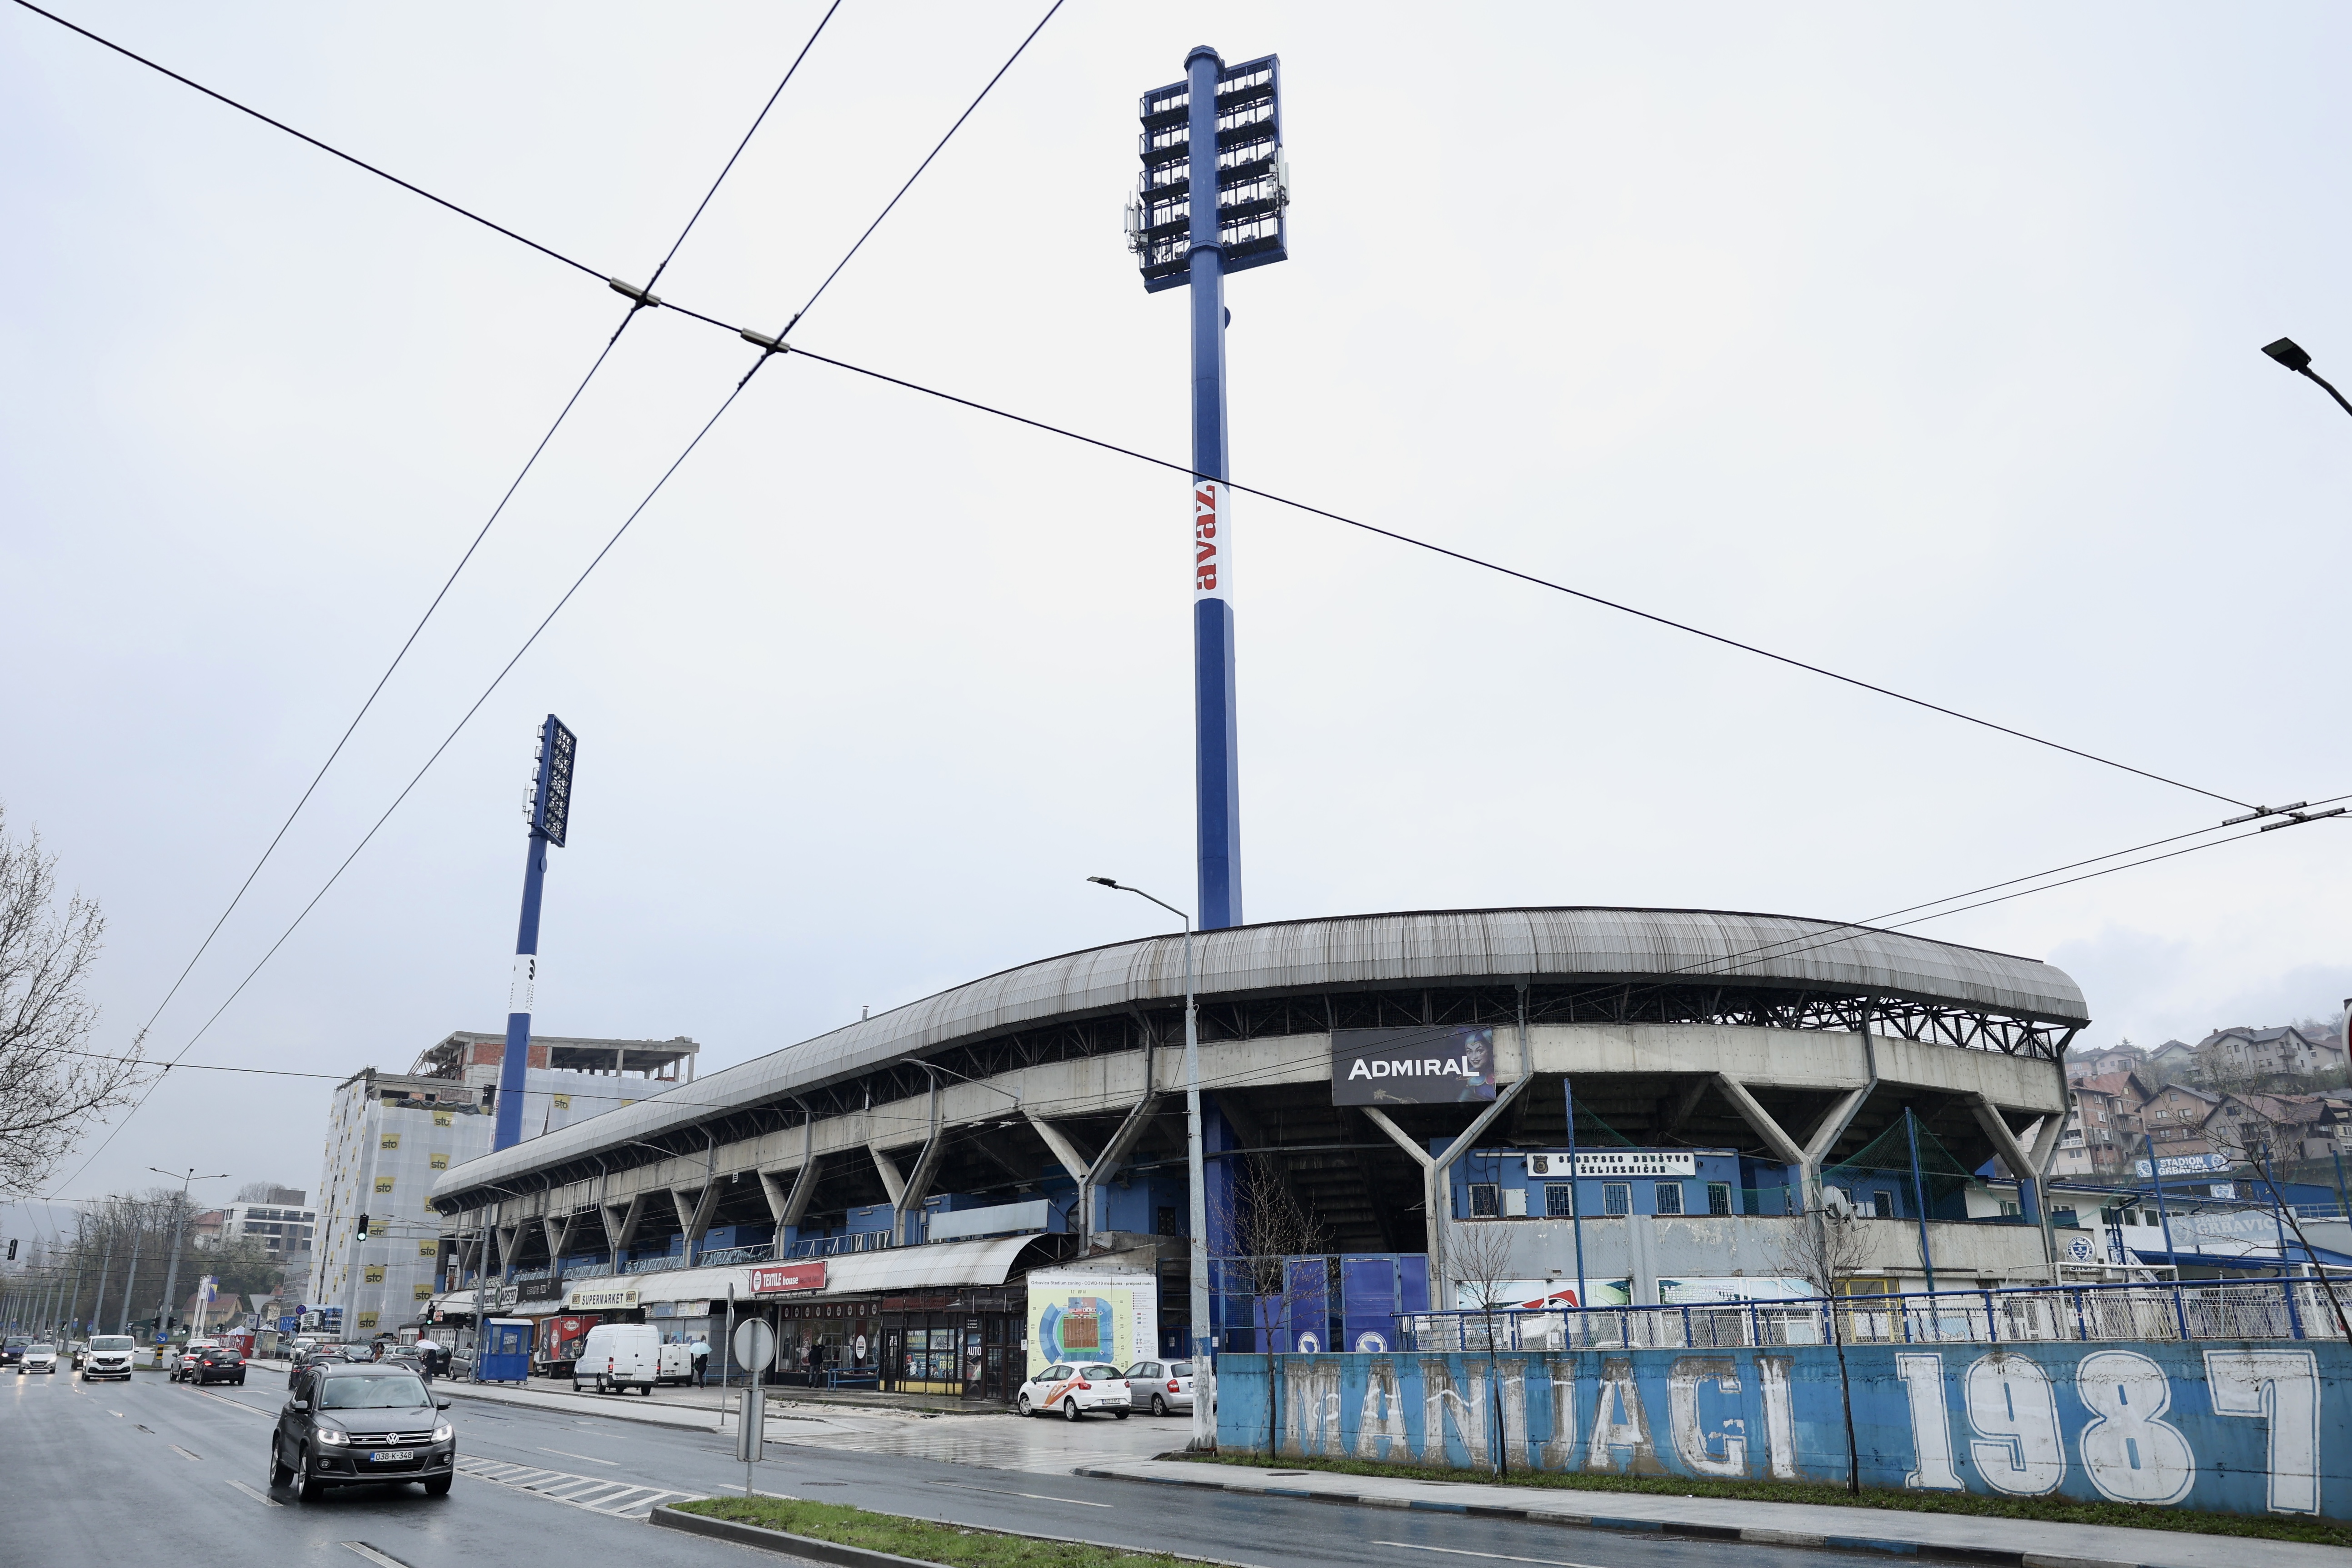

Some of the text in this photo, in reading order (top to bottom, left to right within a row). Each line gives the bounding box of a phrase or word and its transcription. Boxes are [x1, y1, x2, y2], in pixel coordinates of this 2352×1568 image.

[1196, 485, 1216, 590] avaz
[1348, 1056, 1480, 1080] ADMIRAL
[554, 1099, 568, 1109] sto
[435, 1117, 450, 1126] sto
[382, 1139, 397, 1149] sto
[1633, 1154, 1689, 1163] DRUŠTVO
[2160, 1156, 2203, 1167] STADION
[431, 1159, 446, 1169] sto
[1581, 1164, 1666, 1174] ŽELJEZNIČAR
[2158, 1164, 2210, 1175] GRBAVICA
[376, 1183, 391, 1193] sto
[2195, 1214, 2235, 1223] STADION
[420, 1246, 435, 1256] sto
[366, 1272, 382, 1283] sto
[763, 1273, 782, 1287] TEXTILE
[783, 1276, 799, 1286] house
[415, 1290, 430, 1300] sto
[582, 1293, 624, 1305] SUPERMARKET
[626, 1293, 636, 1301] BEST
[359, 1318, 375, 1328] sto
[967, 1347, 981, 1356] AUTO
[1281, 1348, 2321, 1516] MANIJACI 1987
[376, 1452, 412, 1460] 038-K-348
